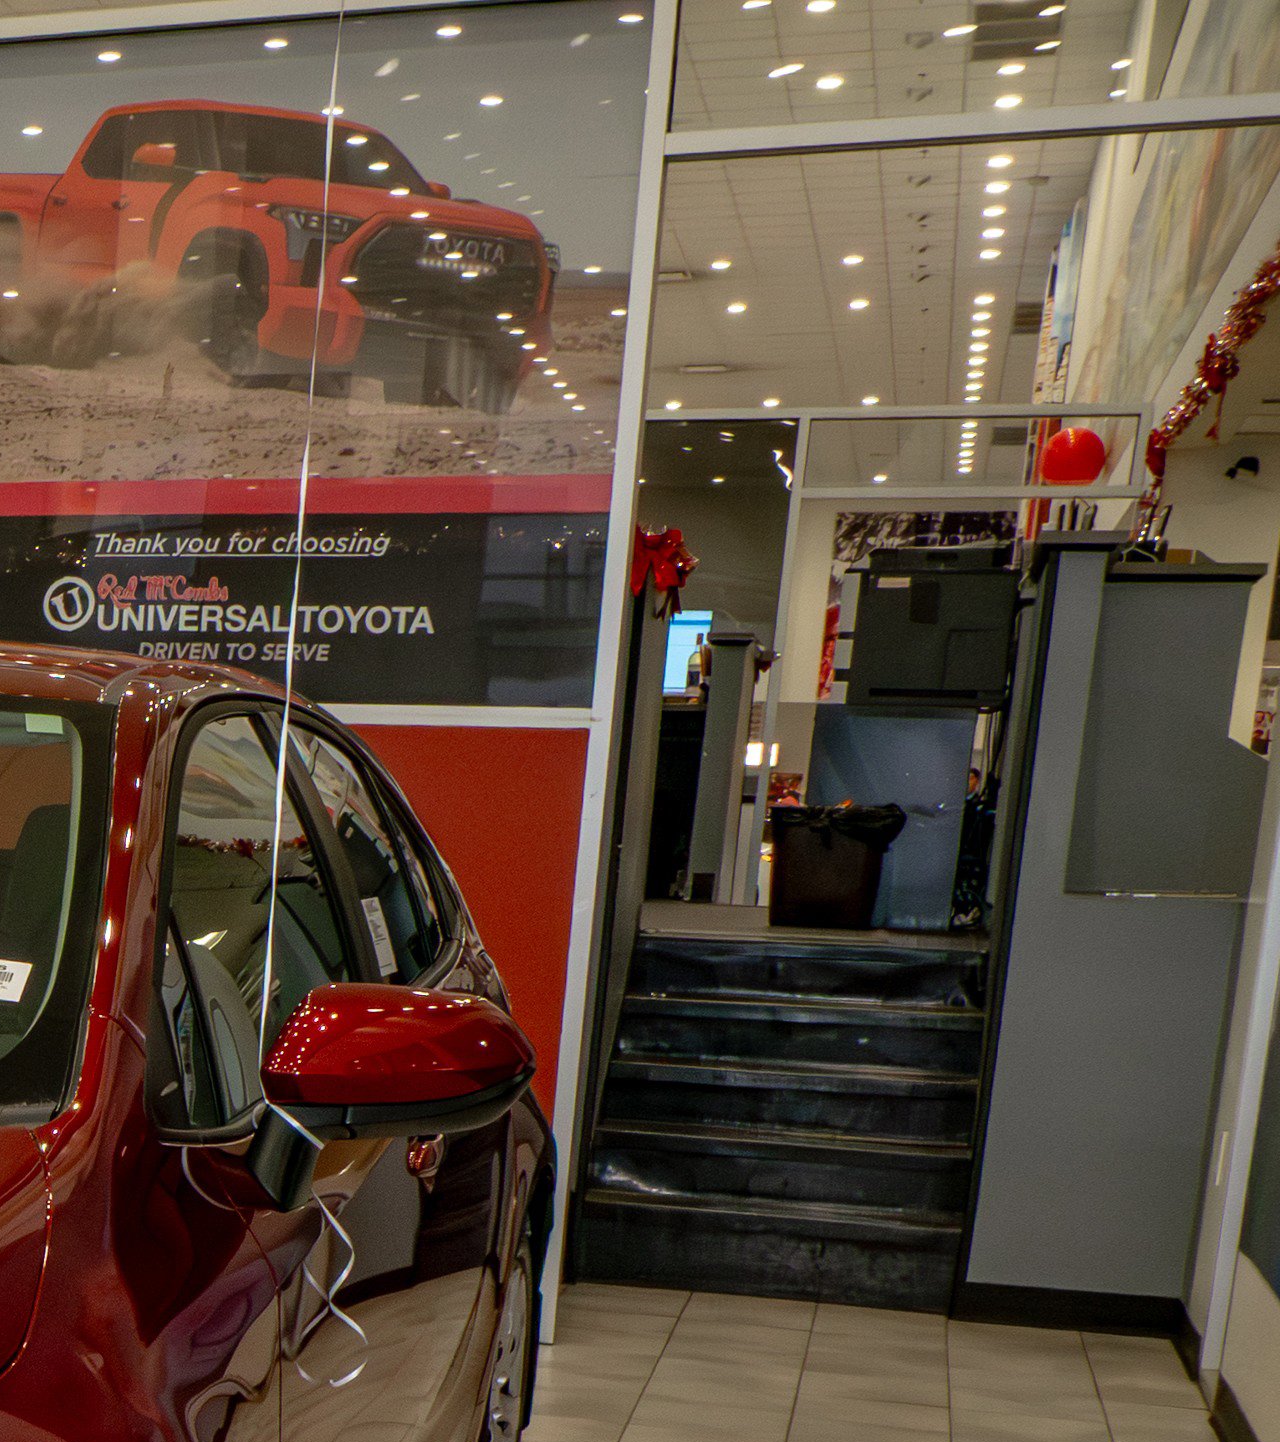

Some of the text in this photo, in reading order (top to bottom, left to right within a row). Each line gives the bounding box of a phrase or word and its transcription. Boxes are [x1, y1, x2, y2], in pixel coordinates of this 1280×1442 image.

[94, 532, 391, 557] Thank you for choosing
[97, 573, 229, 609] Red McCombs
[97, 604, 434, 635] UNIVERSAL TOYOTA
[139, 642, 331, 662] DRIVEN TO SERVE
